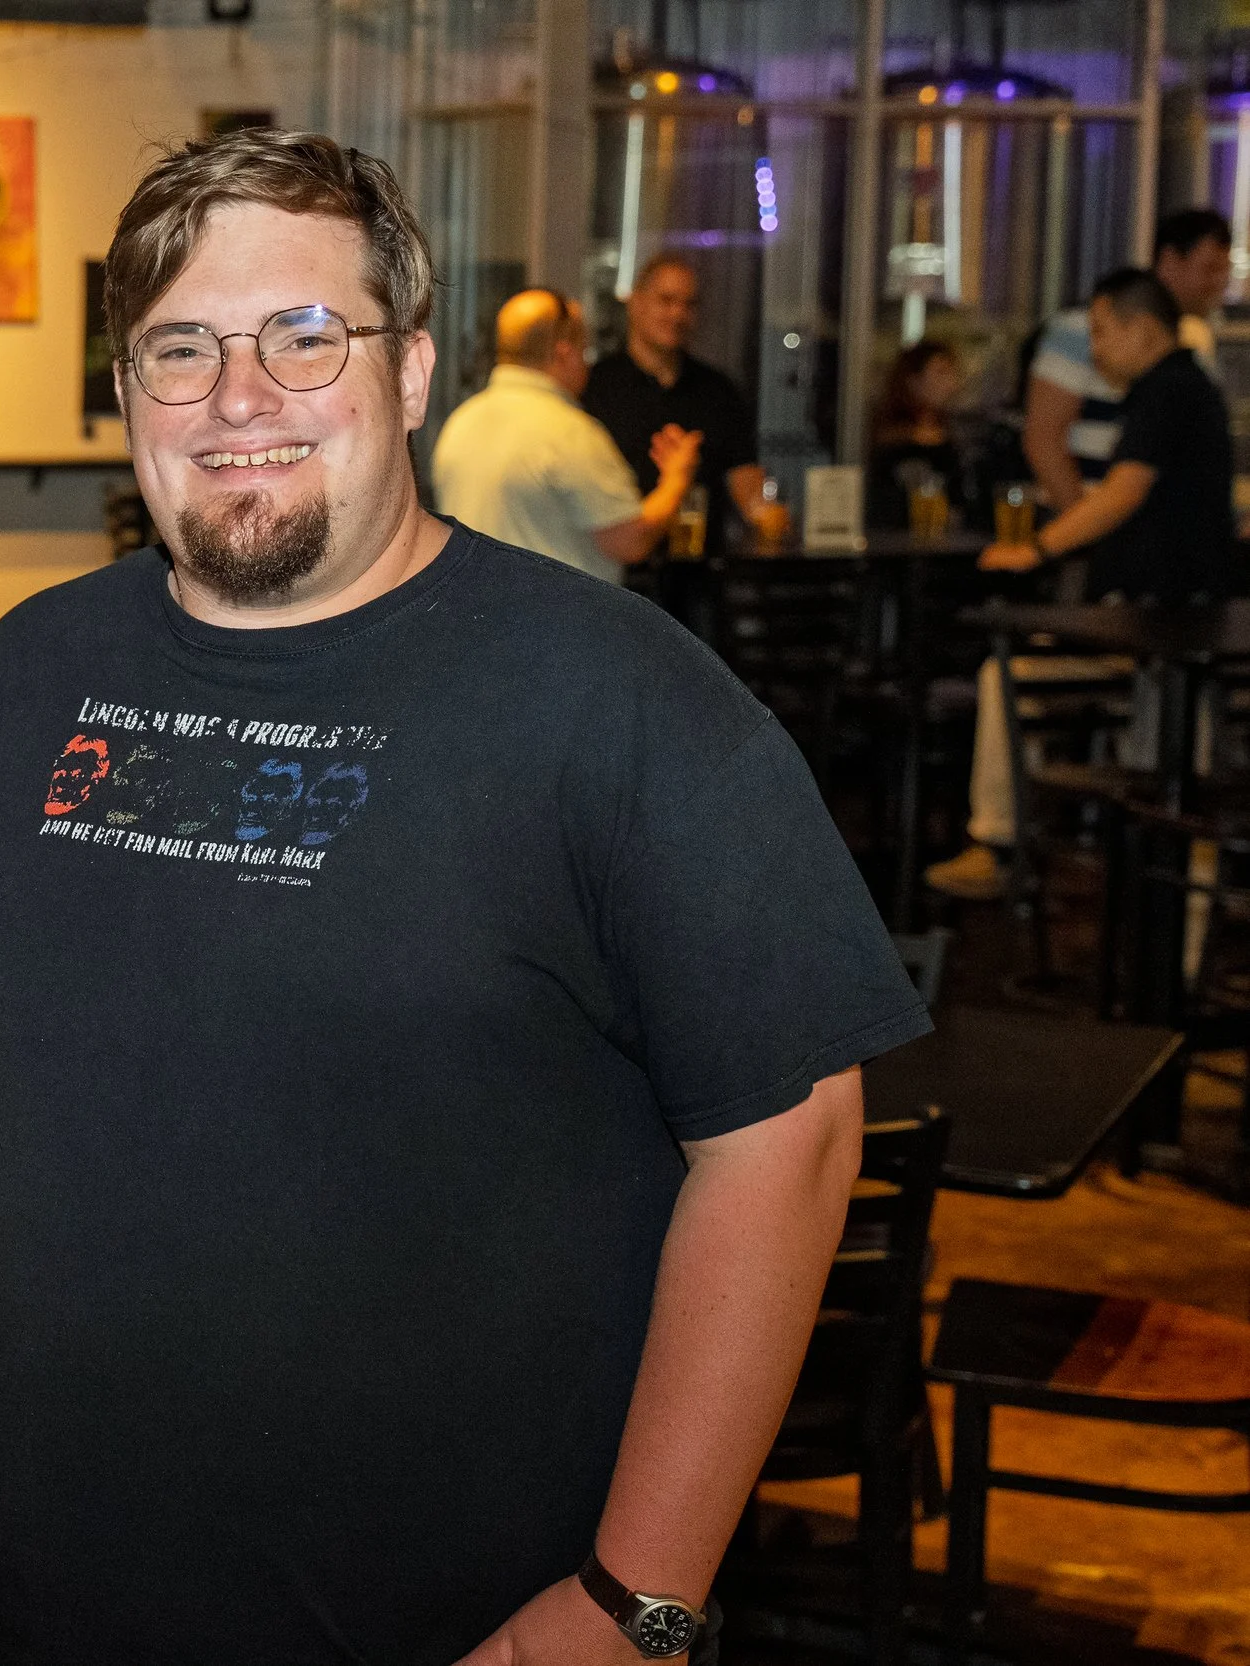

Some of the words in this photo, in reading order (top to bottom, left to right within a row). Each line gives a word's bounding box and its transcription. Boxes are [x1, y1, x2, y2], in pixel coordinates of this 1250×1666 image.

[38, 818, 72, 836] AND
[71, 821, 94, 842] HE
[123, 831, 157, 855] FAN
[155, 836, 194, 859] MAIL
[195, 841, 240, 863] FROM
[240, 842, 277, 865] KARL
[279, 845, 327, 870] MARX
